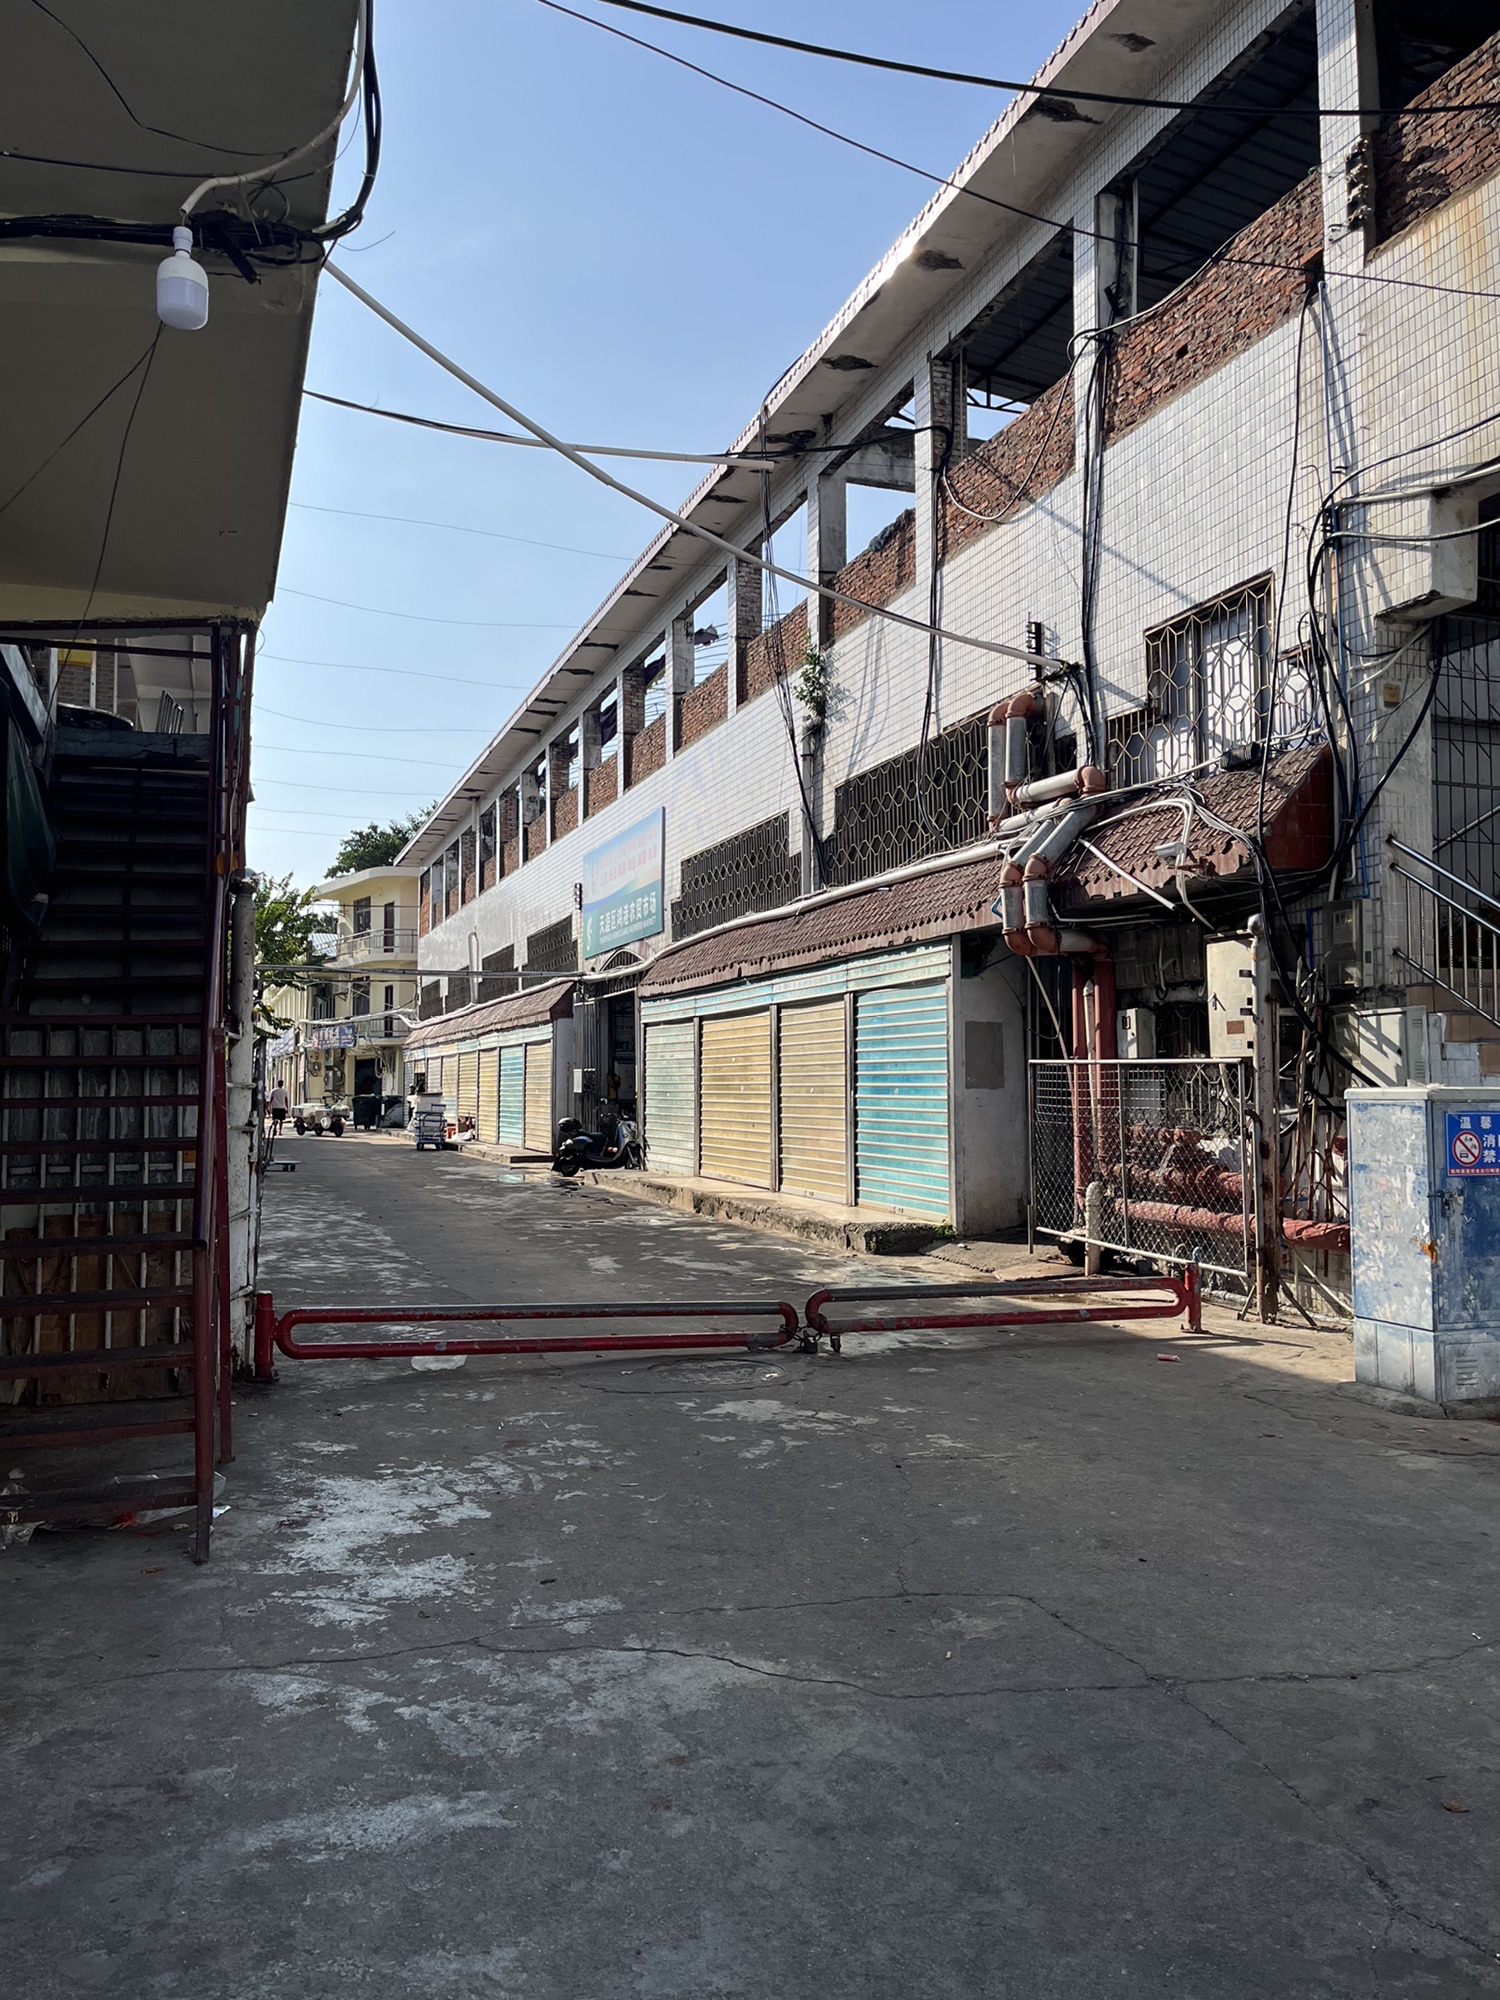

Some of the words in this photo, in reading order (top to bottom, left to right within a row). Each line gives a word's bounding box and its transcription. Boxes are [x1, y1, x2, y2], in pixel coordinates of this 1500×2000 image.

[1460, 1116, 1492, 1129] 温馨
[1483, 1133, 1500, 1148] 消
[1482, 1149, 1500, 1163] 禁
